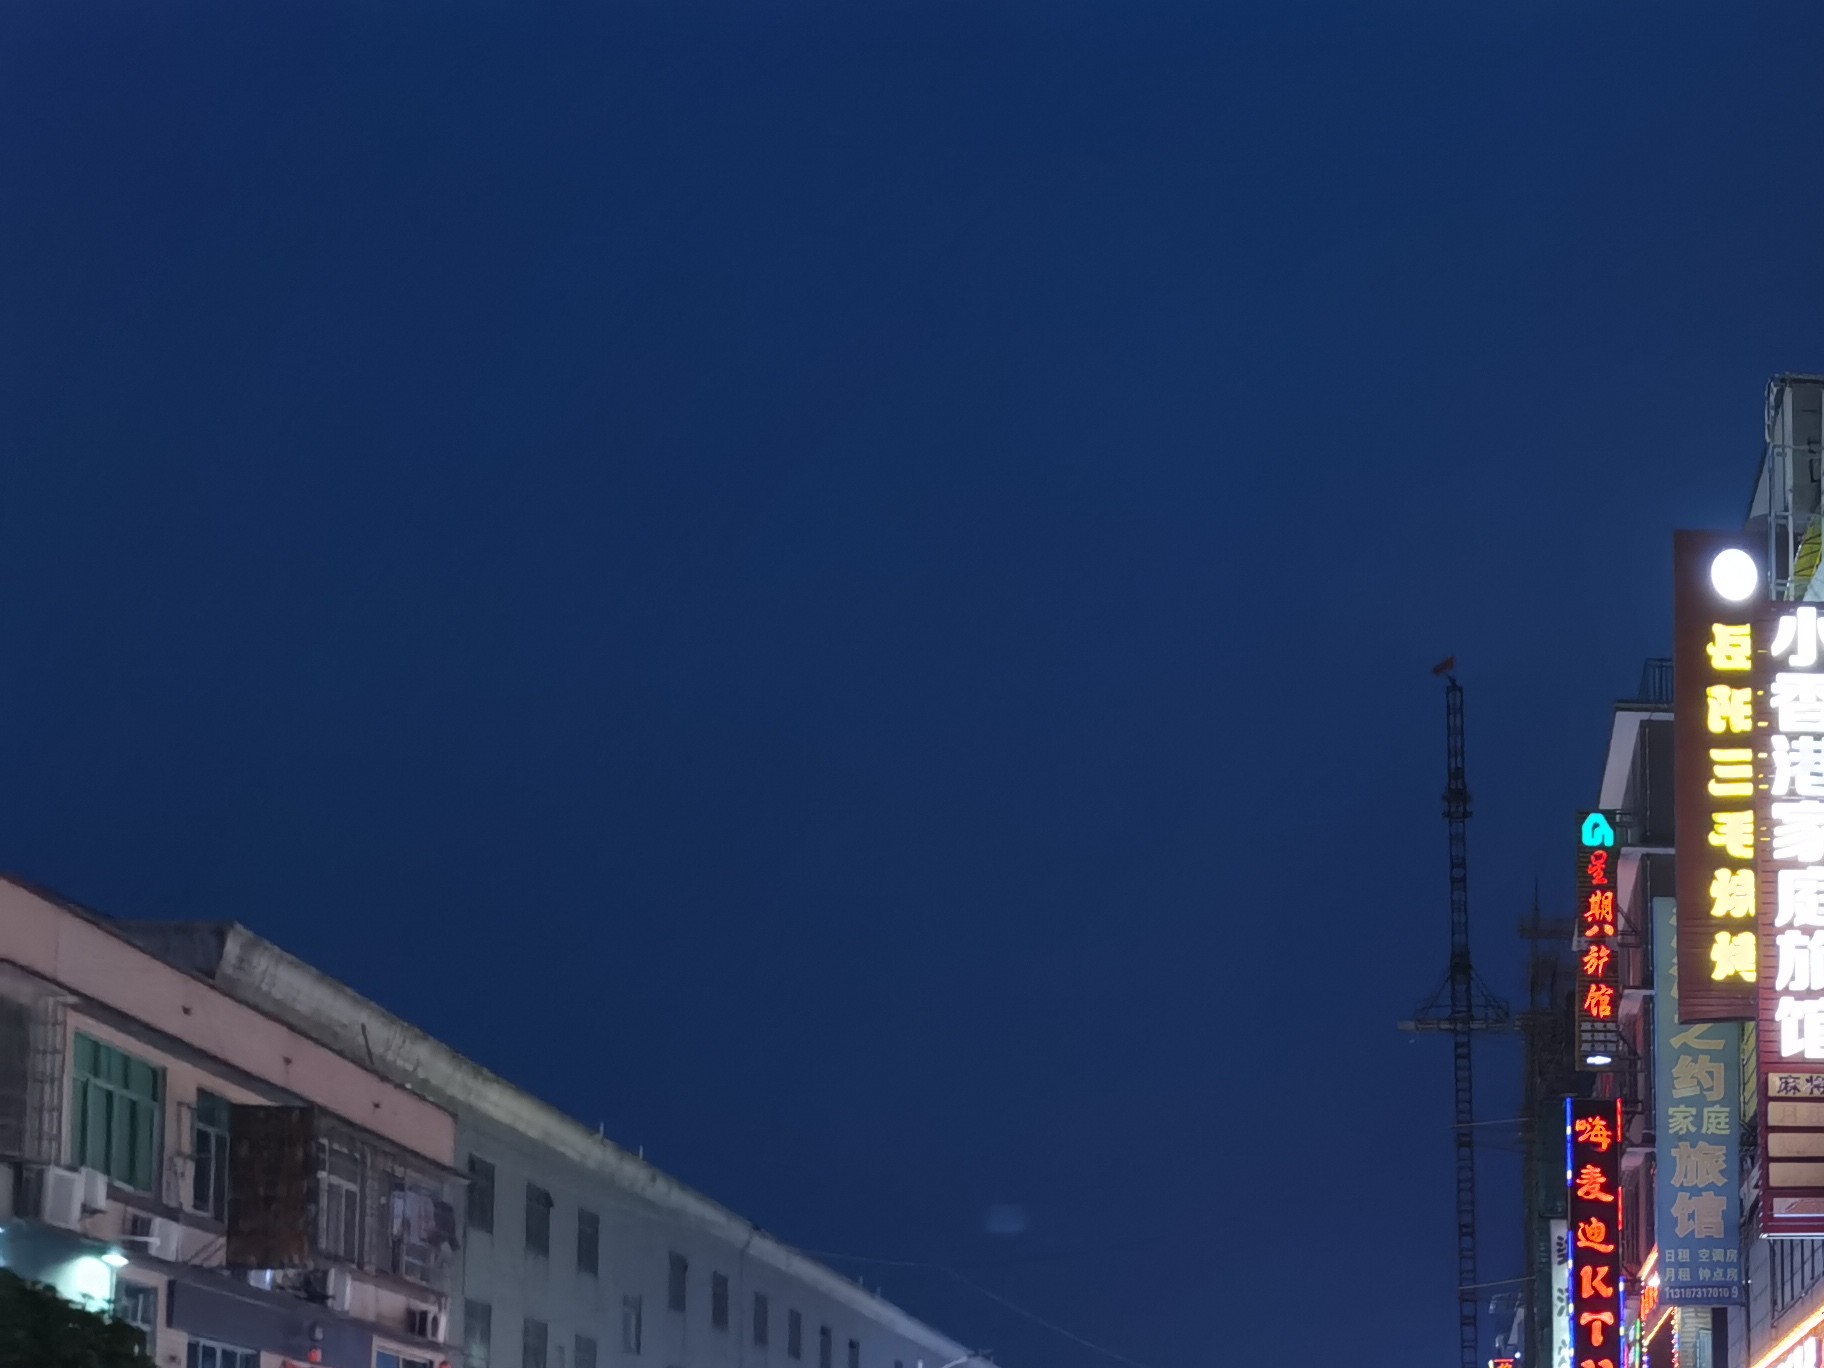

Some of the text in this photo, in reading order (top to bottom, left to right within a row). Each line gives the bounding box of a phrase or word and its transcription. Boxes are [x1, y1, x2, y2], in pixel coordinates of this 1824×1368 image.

[1668, 1105, 1731, 1136] 家庭
[1670, 1141, 1728, 1238] 旅馆
[1665, 1249, 1738, 1263] 日租 空调房
